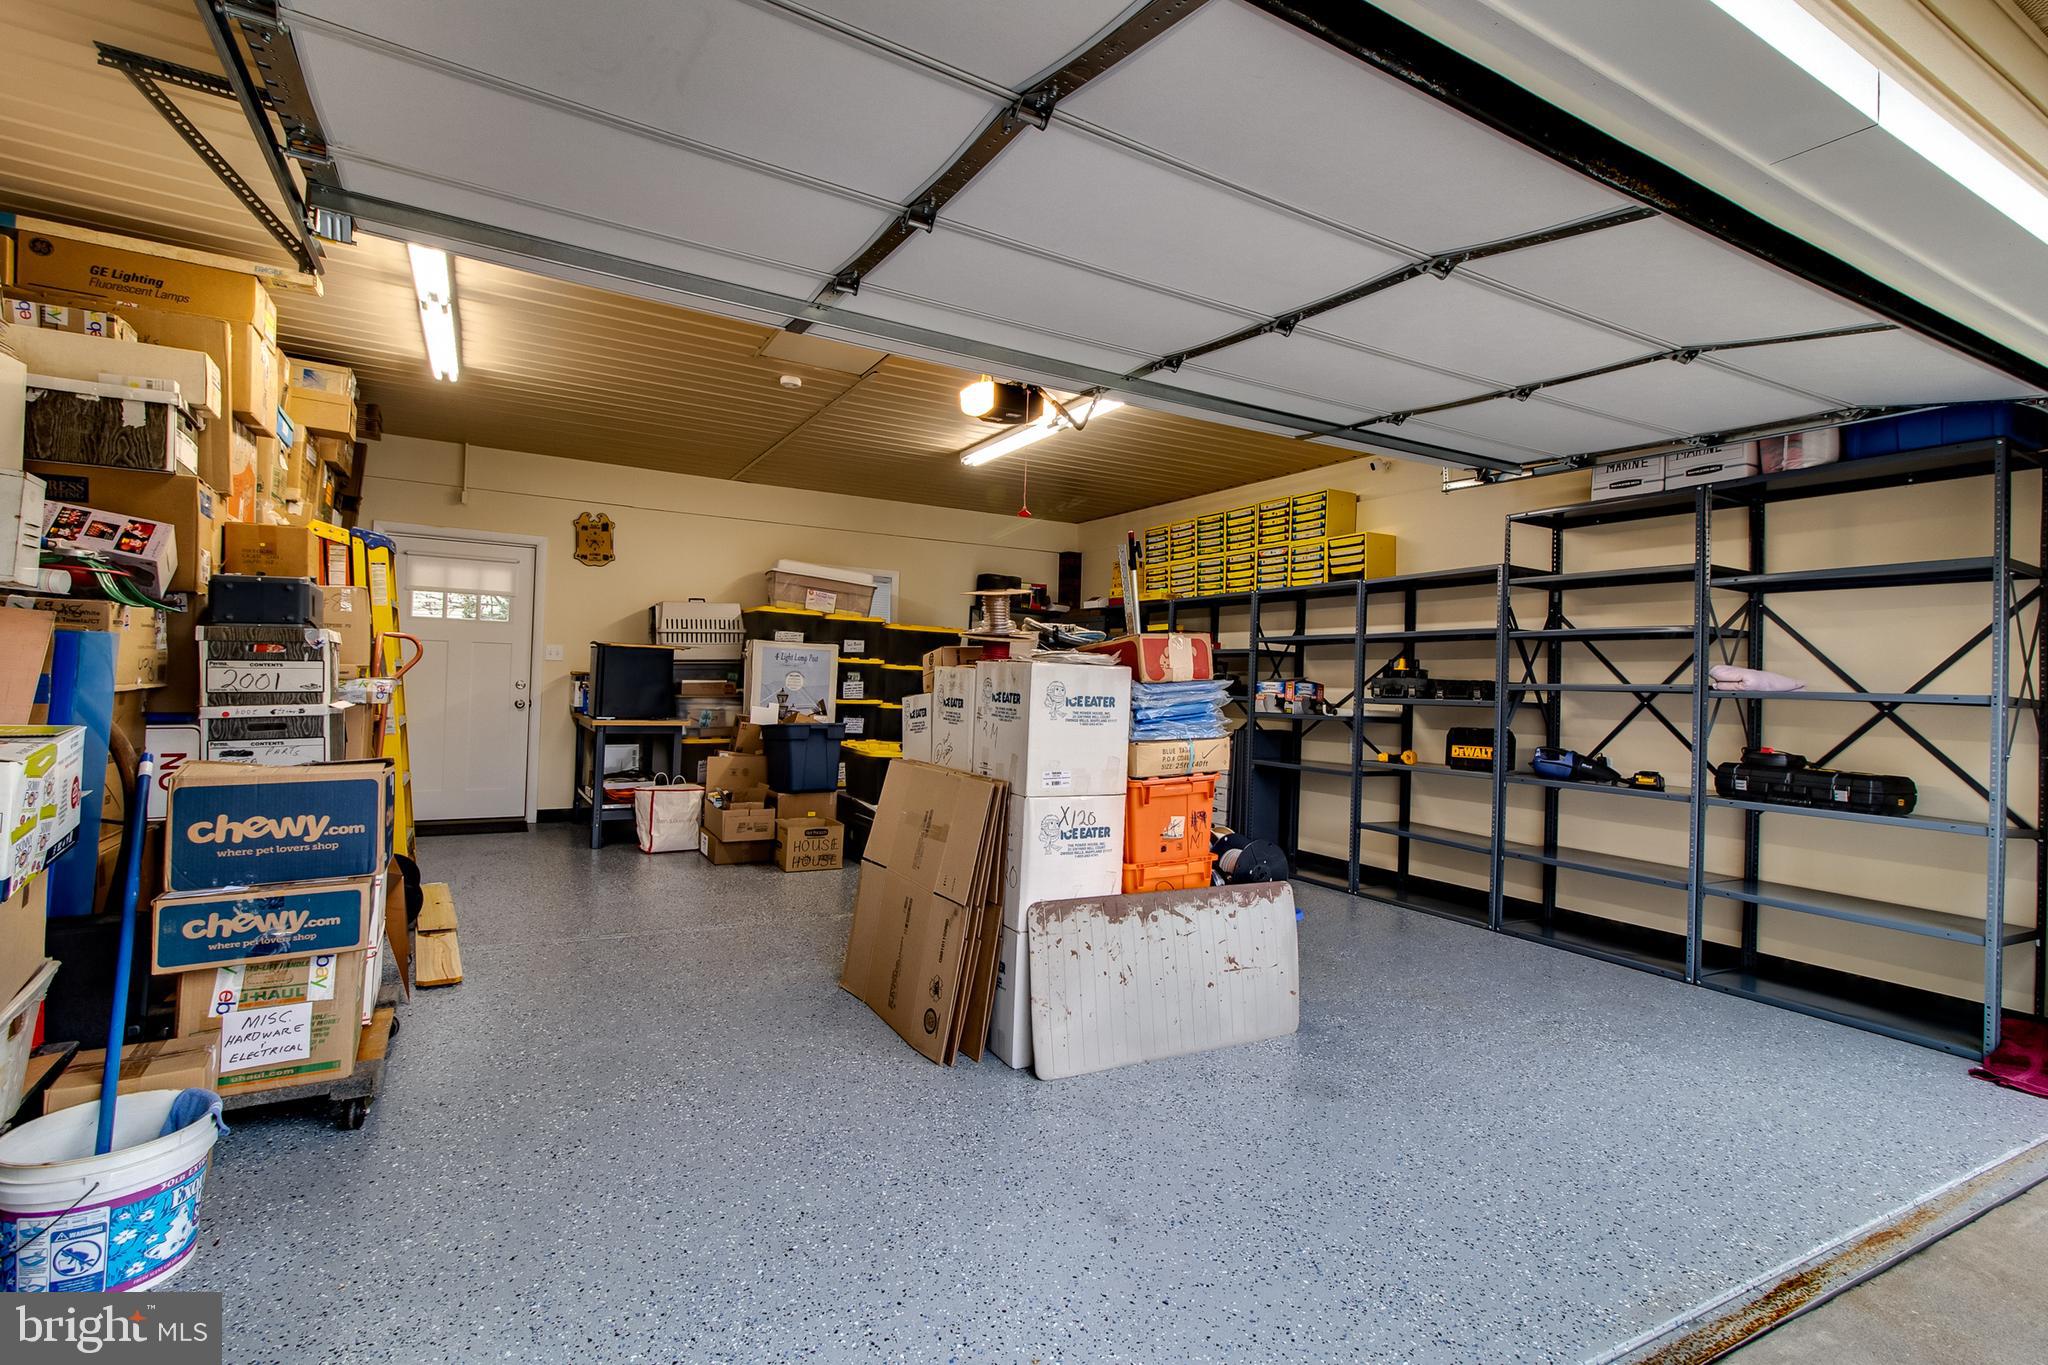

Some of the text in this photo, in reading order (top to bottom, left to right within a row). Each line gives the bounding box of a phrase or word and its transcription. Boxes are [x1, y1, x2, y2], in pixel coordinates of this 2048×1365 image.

[90, 265, 164, 288] GE Lighting
[89, 277, 191, 304] Fluorescent Lamps
[1605, 460, 1649, 474] MARINE
[775, 652, 819, 664] 4 Light Lamp Post
[221, 669, 280, 692] 2001
[950, 698, 964, 708] EATER
[992, 692, 1021, 705] ICE EATER
[1065, 696, 1116, 708] ICE EATER
[916, 708, 927, 718] EATER
[1452, 745, 1494, 760] DEWALT
[187, 814, 366, 844] chewy.com
[1060, 826, 1111, 840] ICE EATER
[216, 842, 340, 858] where pet lovers shop
[794, 838, 840, 852] HOUSE
[792, 854, 838, 868] HOUSE
[182, 910, 341, 940] chewy.com
[208, 932, 317, 951] where pet lovers shop
[242, 1010, 293, 1030] MISC.
[224, 1024, 304, 1048] HARDWARE
[229, 1044, 303, 1064] ELECTRICAL
[231, 1068, 294, 1083] uhaul.com
